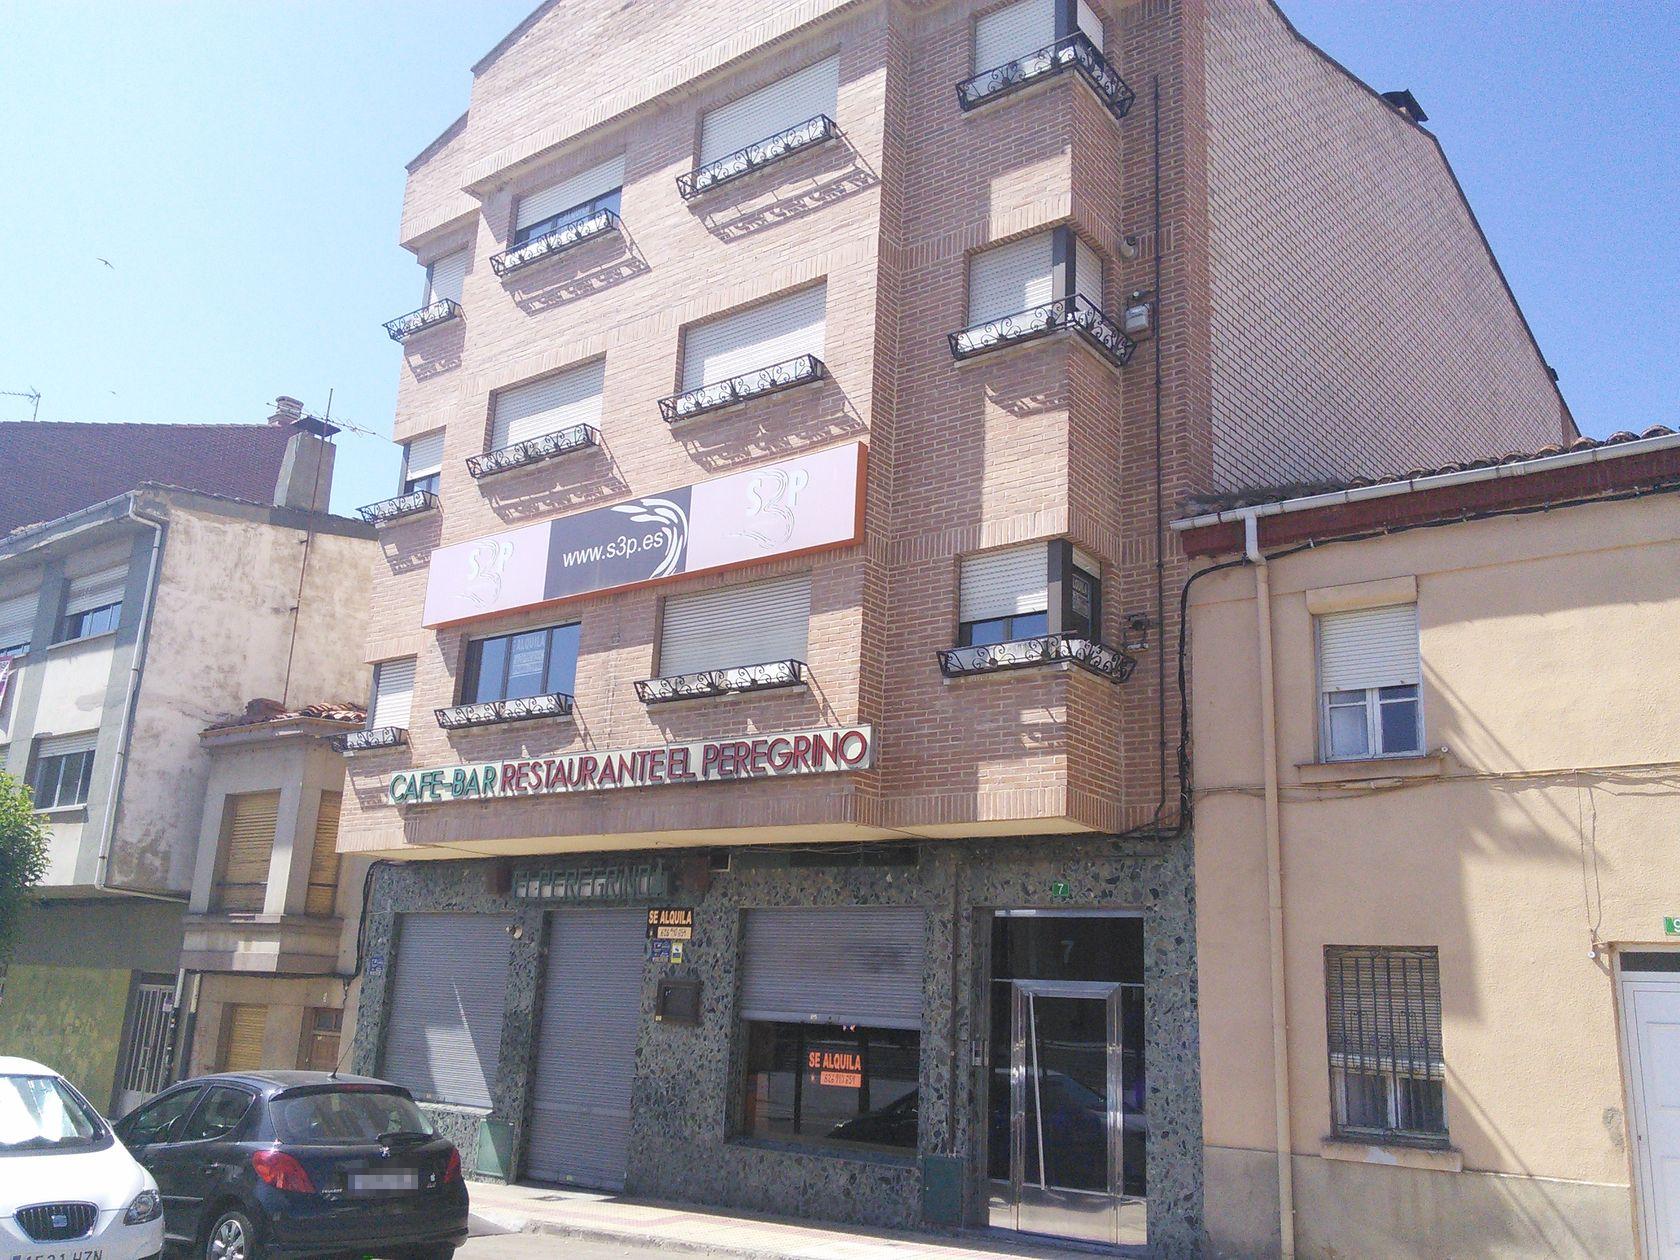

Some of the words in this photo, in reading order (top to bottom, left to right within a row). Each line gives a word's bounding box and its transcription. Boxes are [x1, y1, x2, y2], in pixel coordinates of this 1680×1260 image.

[563, 531, 663, 568] www.s3p.es
[390, 765, 497, 802] CAFE-BAR
[501, 749, 664, 792] RESTAURANTE
[667, 747, 695, 779] EL
[702, 730, 867, 780] PEREGRINO
[1058, 883, 1064, 895] 7
[649, 910, 659, 924] SE
[660, 910, 692, 924] ALQUILA
[809, 1051, 821, 1068] SE
[822, 1052, 861, 1071] ALQUILA
